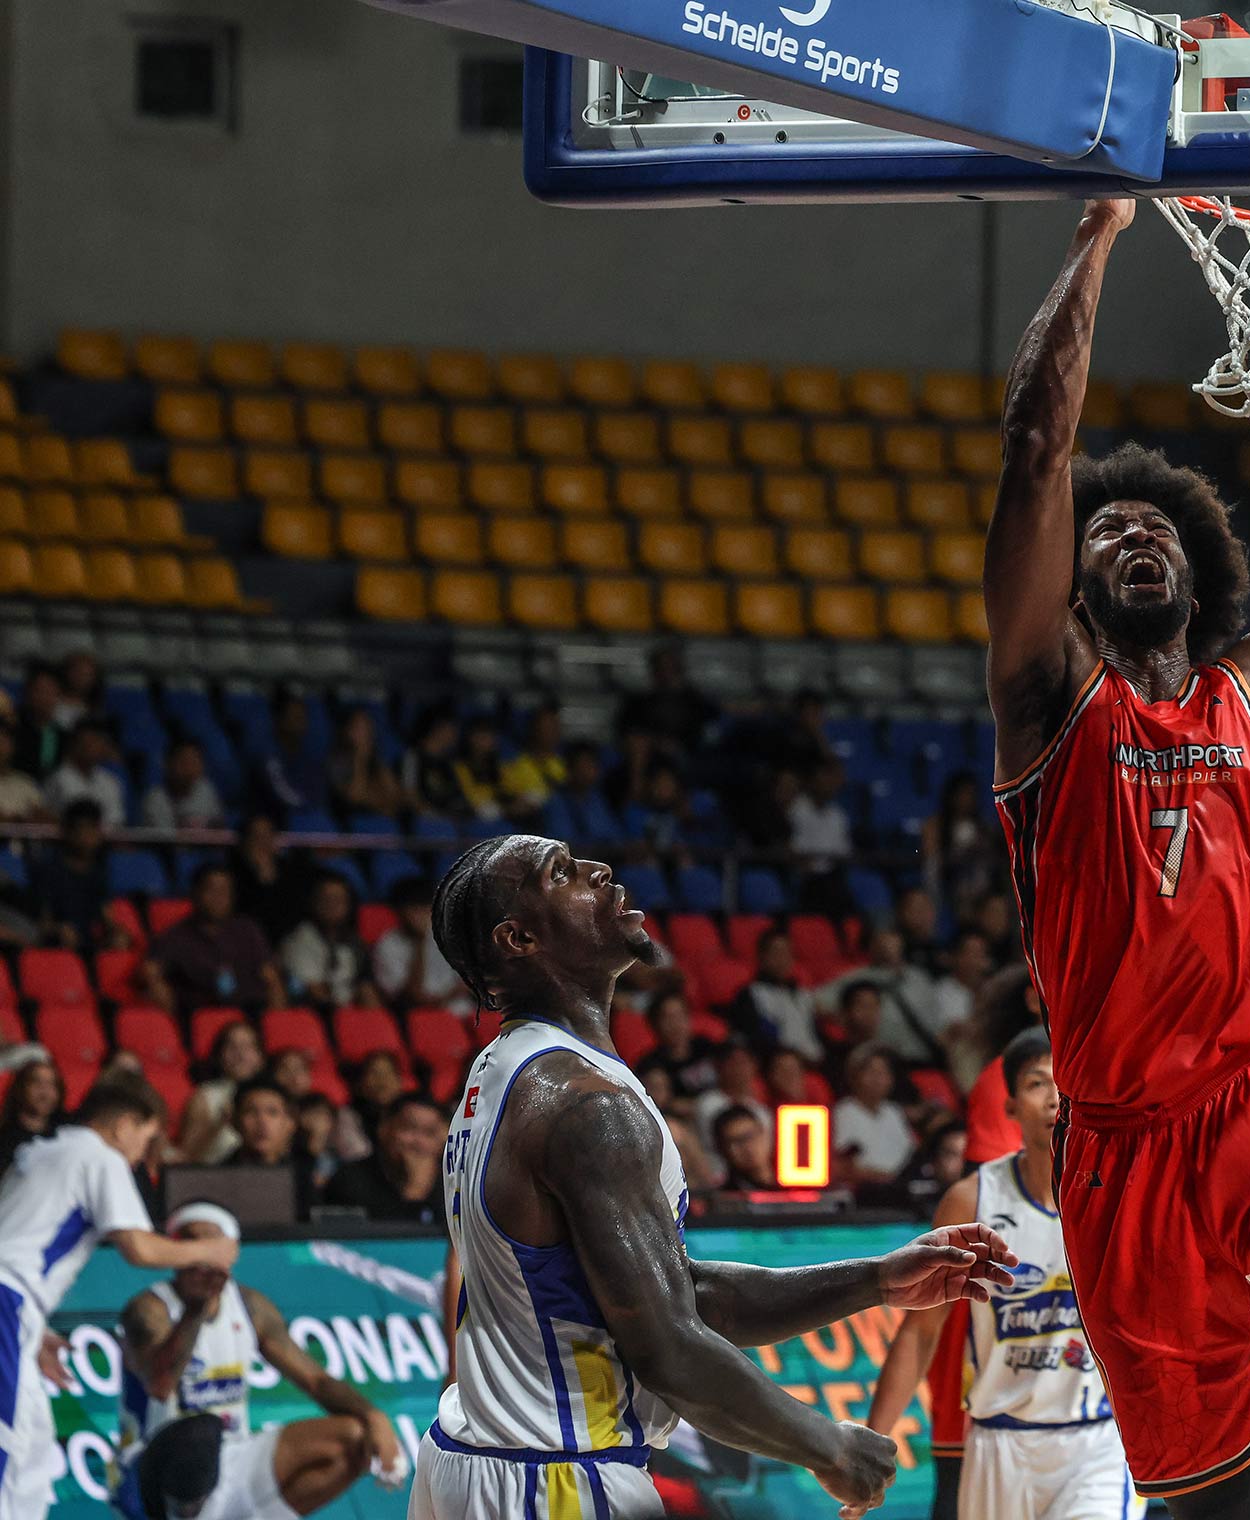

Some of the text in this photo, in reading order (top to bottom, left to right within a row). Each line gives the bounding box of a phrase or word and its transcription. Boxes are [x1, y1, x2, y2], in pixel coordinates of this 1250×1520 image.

[682, 1, 900, 94] Schelde Sports
[1117, 743, 1244, 771] NORTHPORT
[1151, 807, 1188, 896] 7
[777, 1105, 829, 1187] 0
